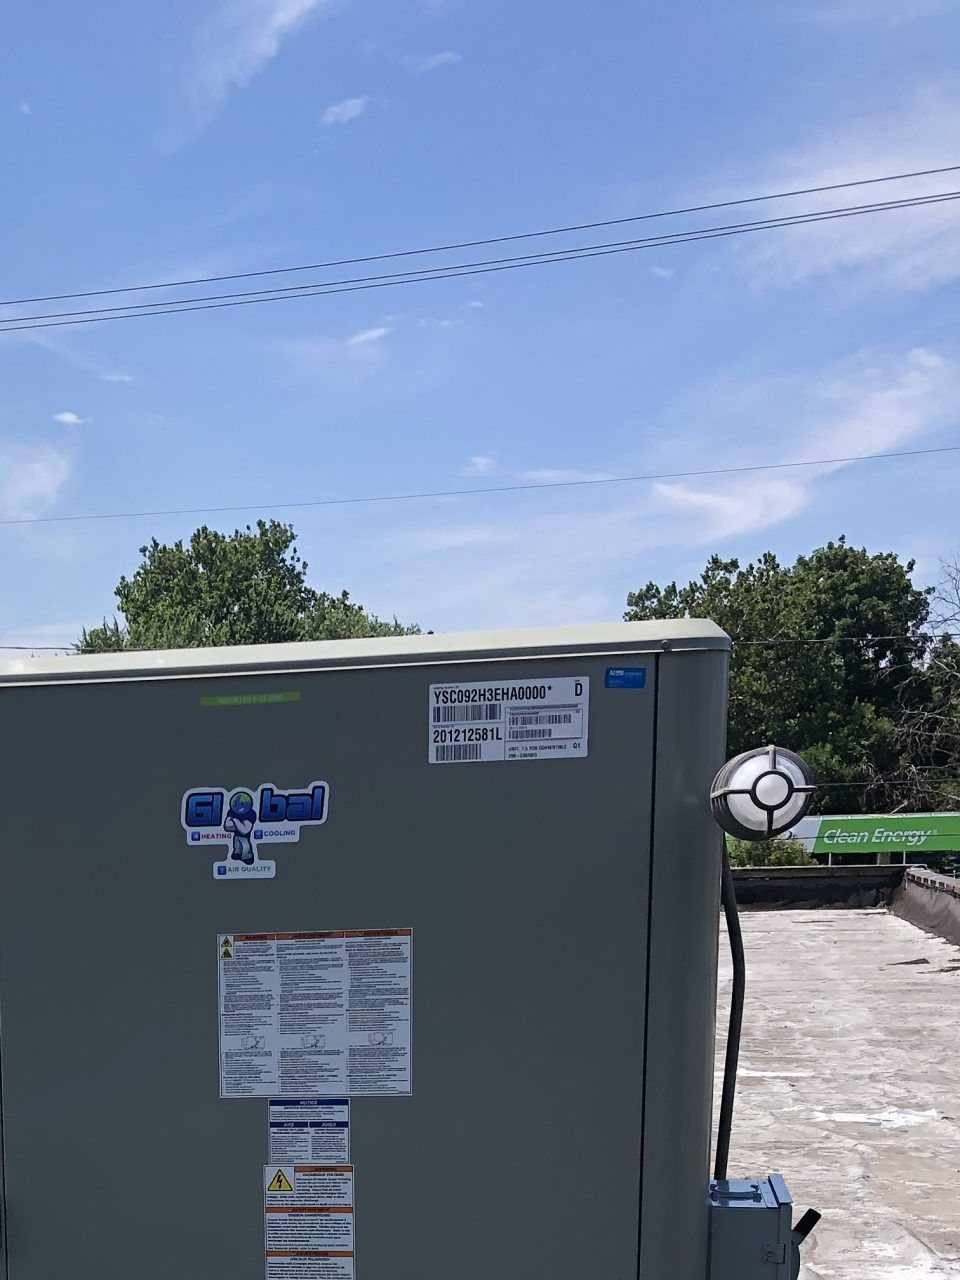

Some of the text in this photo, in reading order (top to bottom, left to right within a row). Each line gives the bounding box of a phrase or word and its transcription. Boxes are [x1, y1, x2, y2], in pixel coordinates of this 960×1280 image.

[574, 683, 582, 697] D
[433, 727, 503, 744] 201212581L
[201, 832, 233, 841] HEATING
[264, 830, 296, 838] COOLING
[823, 828, 931, 846] Clean Energy
[241, 865, 271, 873] QUALITY
